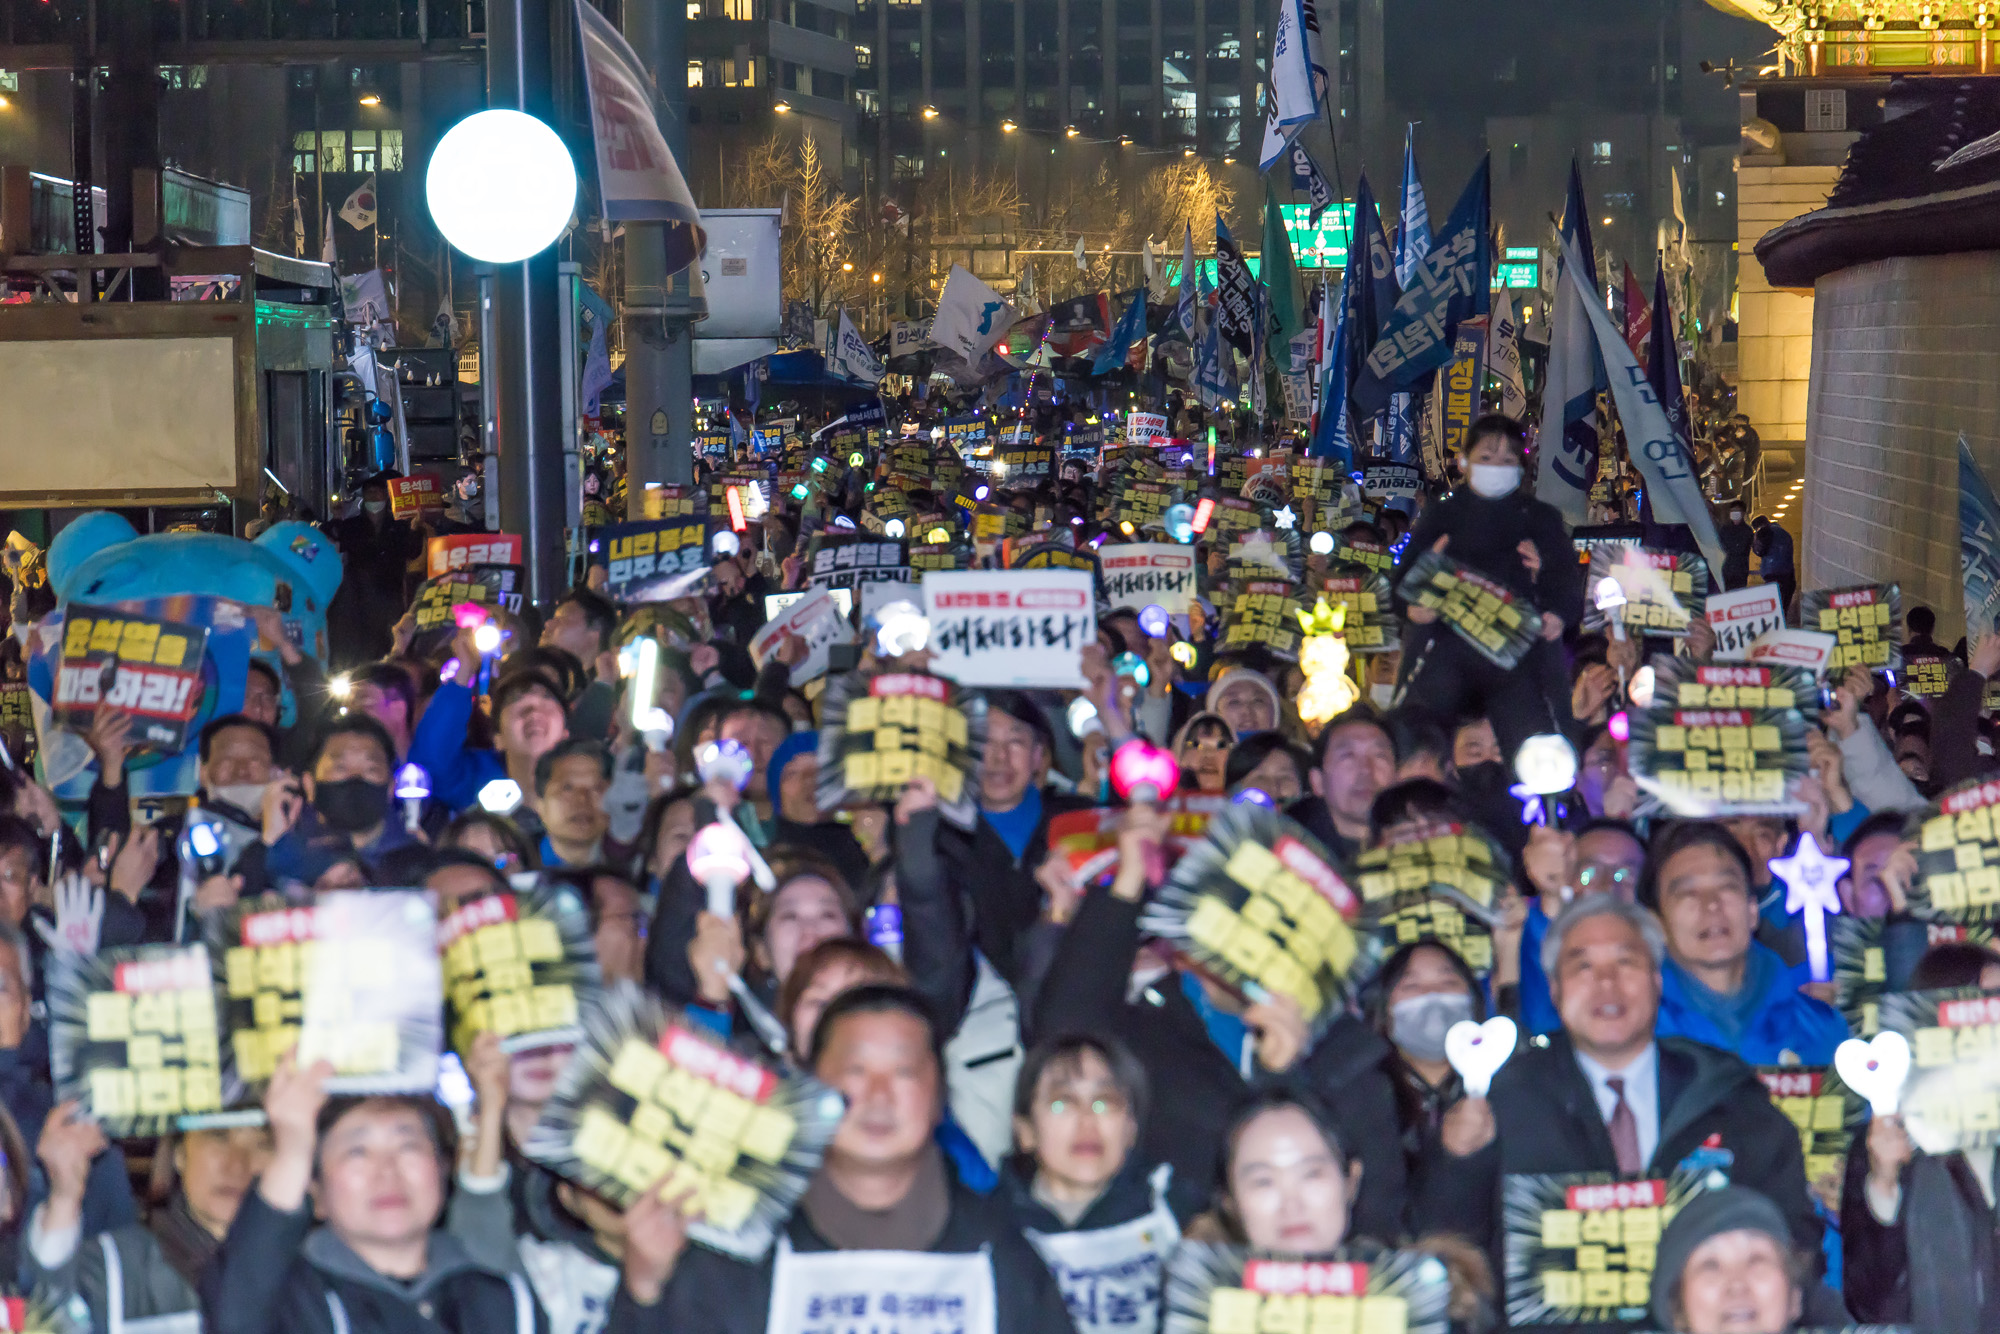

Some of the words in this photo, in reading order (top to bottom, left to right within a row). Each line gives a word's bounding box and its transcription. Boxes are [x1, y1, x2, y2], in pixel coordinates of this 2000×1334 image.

[400, 480, 433, 494] 윤석열
[1365, 478, 1424, 491] 수사하라!
[609, 523, 705, 561] 내란종식
[608, 547, 704, 584] 민주수호
[938, 614, 1088, 657] 해체하라!
